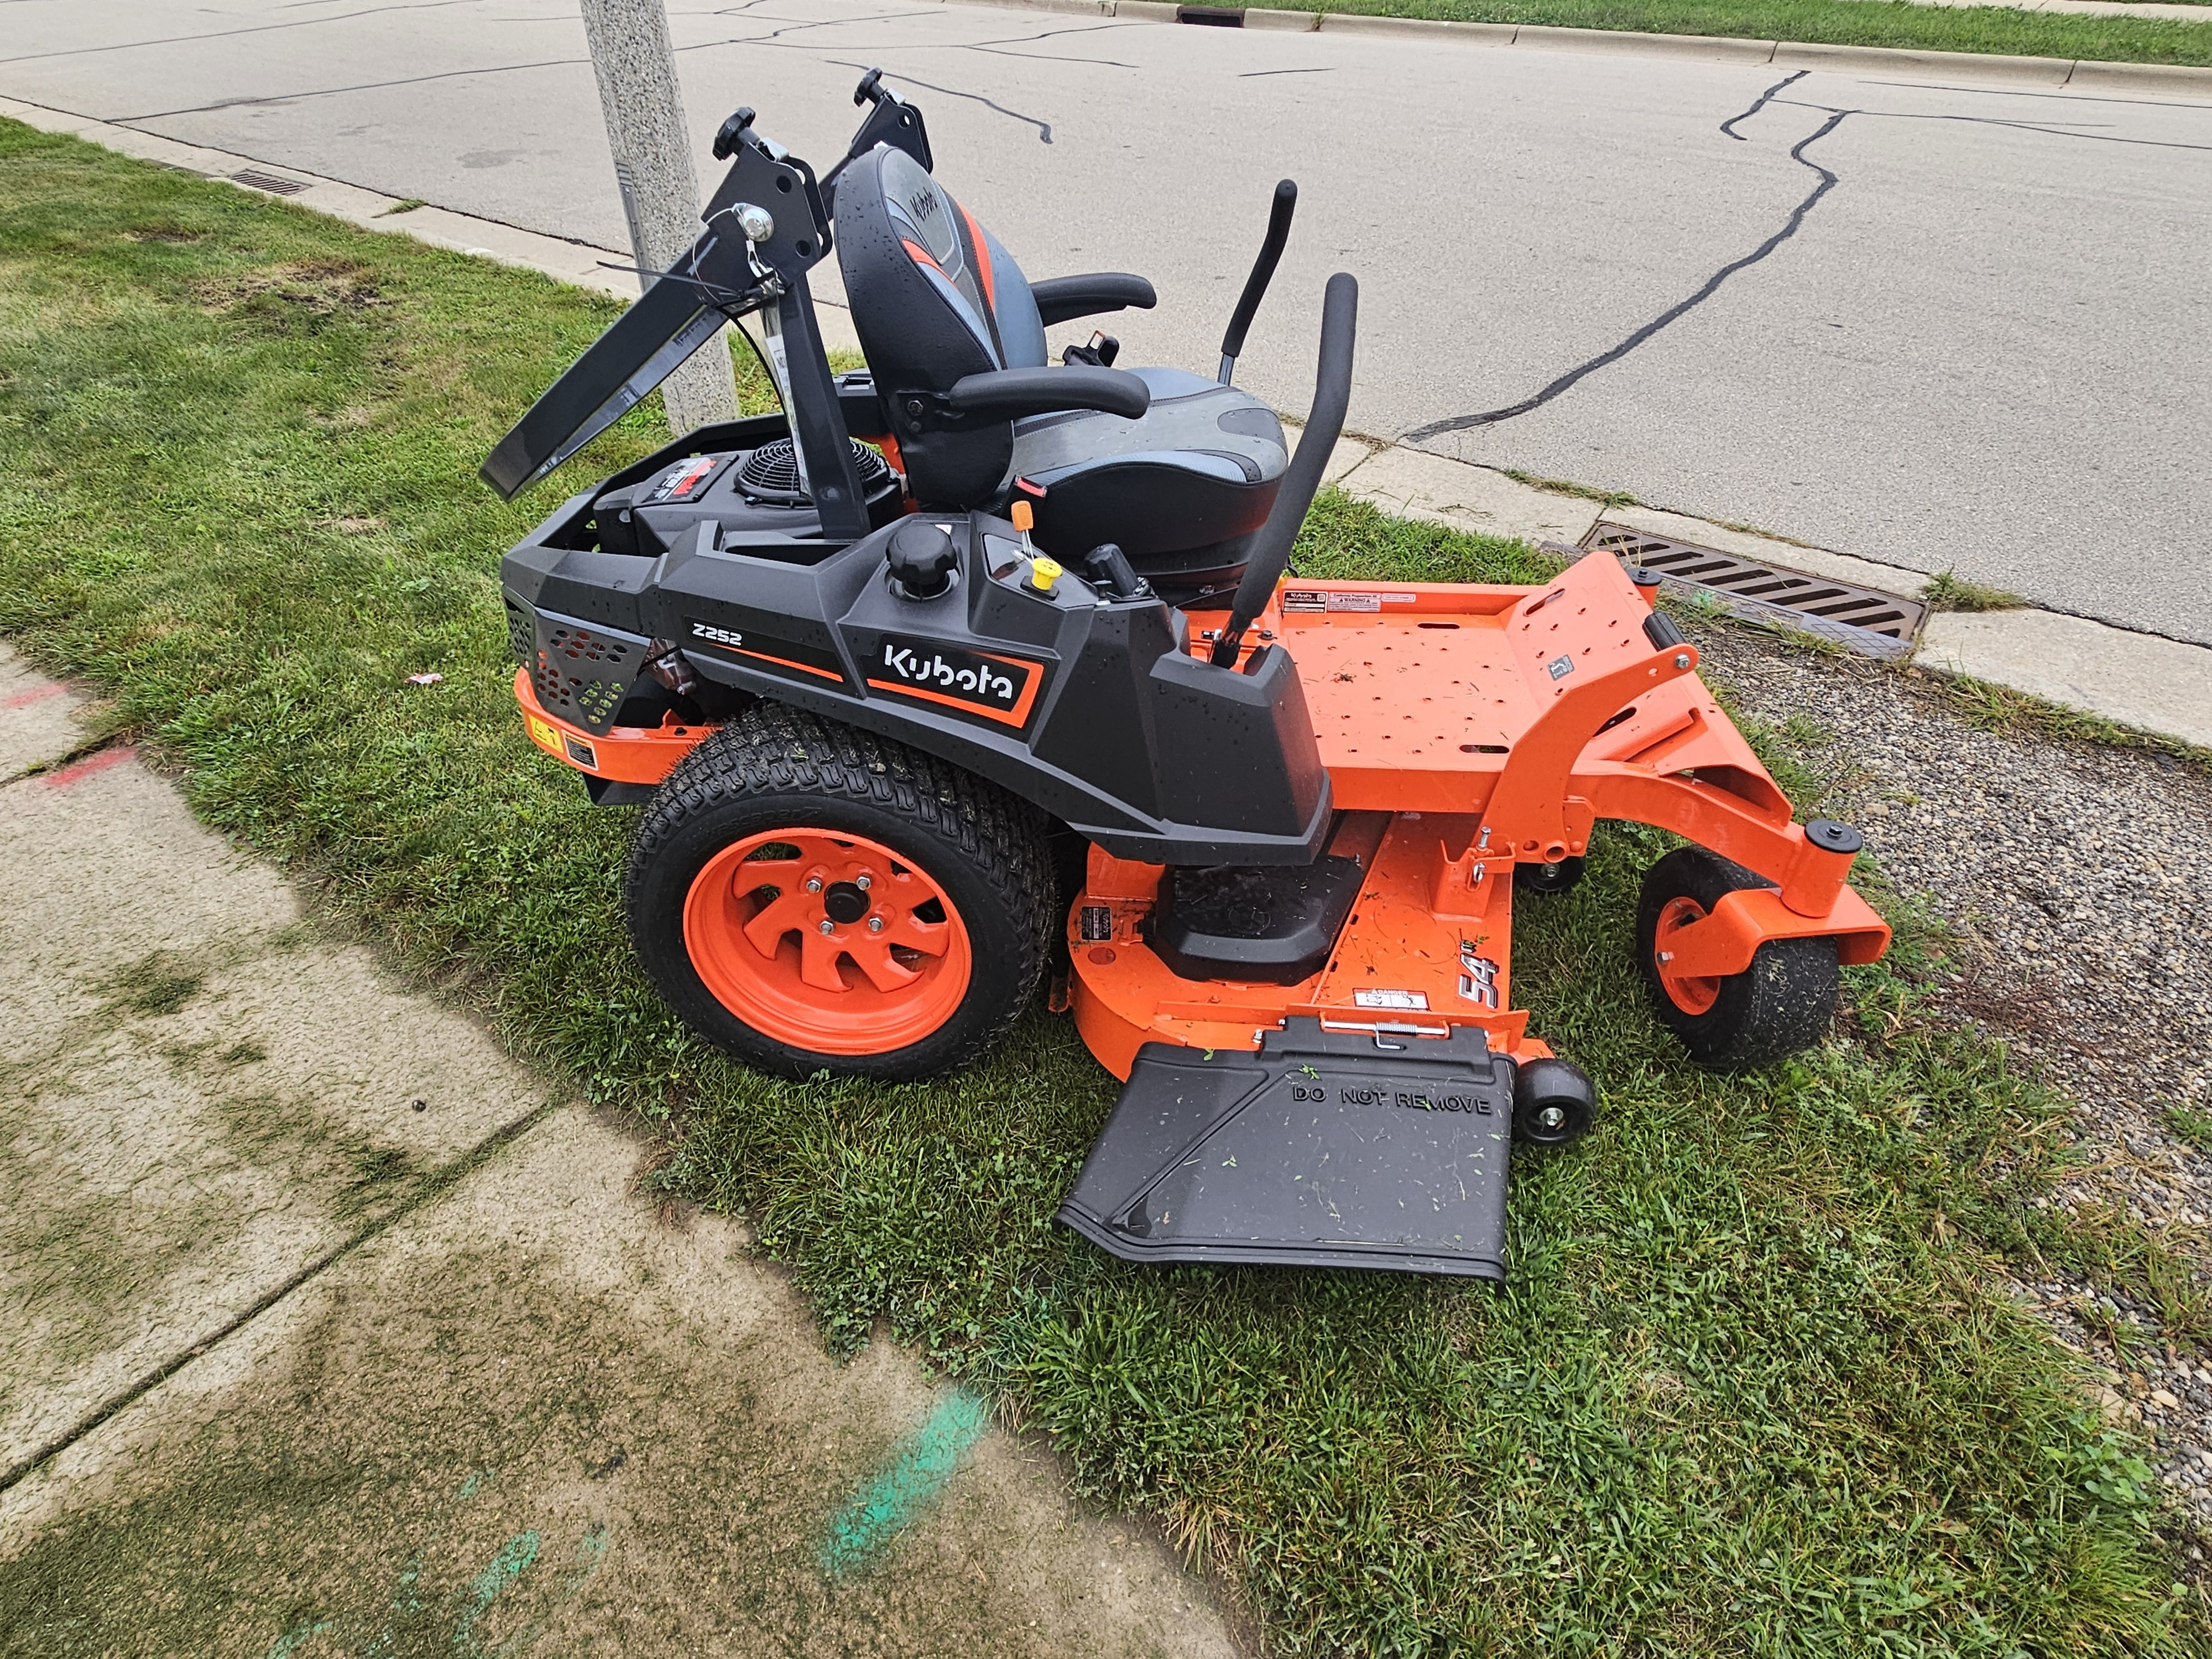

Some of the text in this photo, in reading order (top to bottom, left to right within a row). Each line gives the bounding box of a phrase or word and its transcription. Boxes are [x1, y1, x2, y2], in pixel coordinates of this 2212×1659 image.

[910, 186, 938, 222] Kubota
[692, 623, 742, 646] Z252
[885, 644, 1013, 699] Kubota
[1293, 1086, 1493, 1115] DO NOT REMOVE
